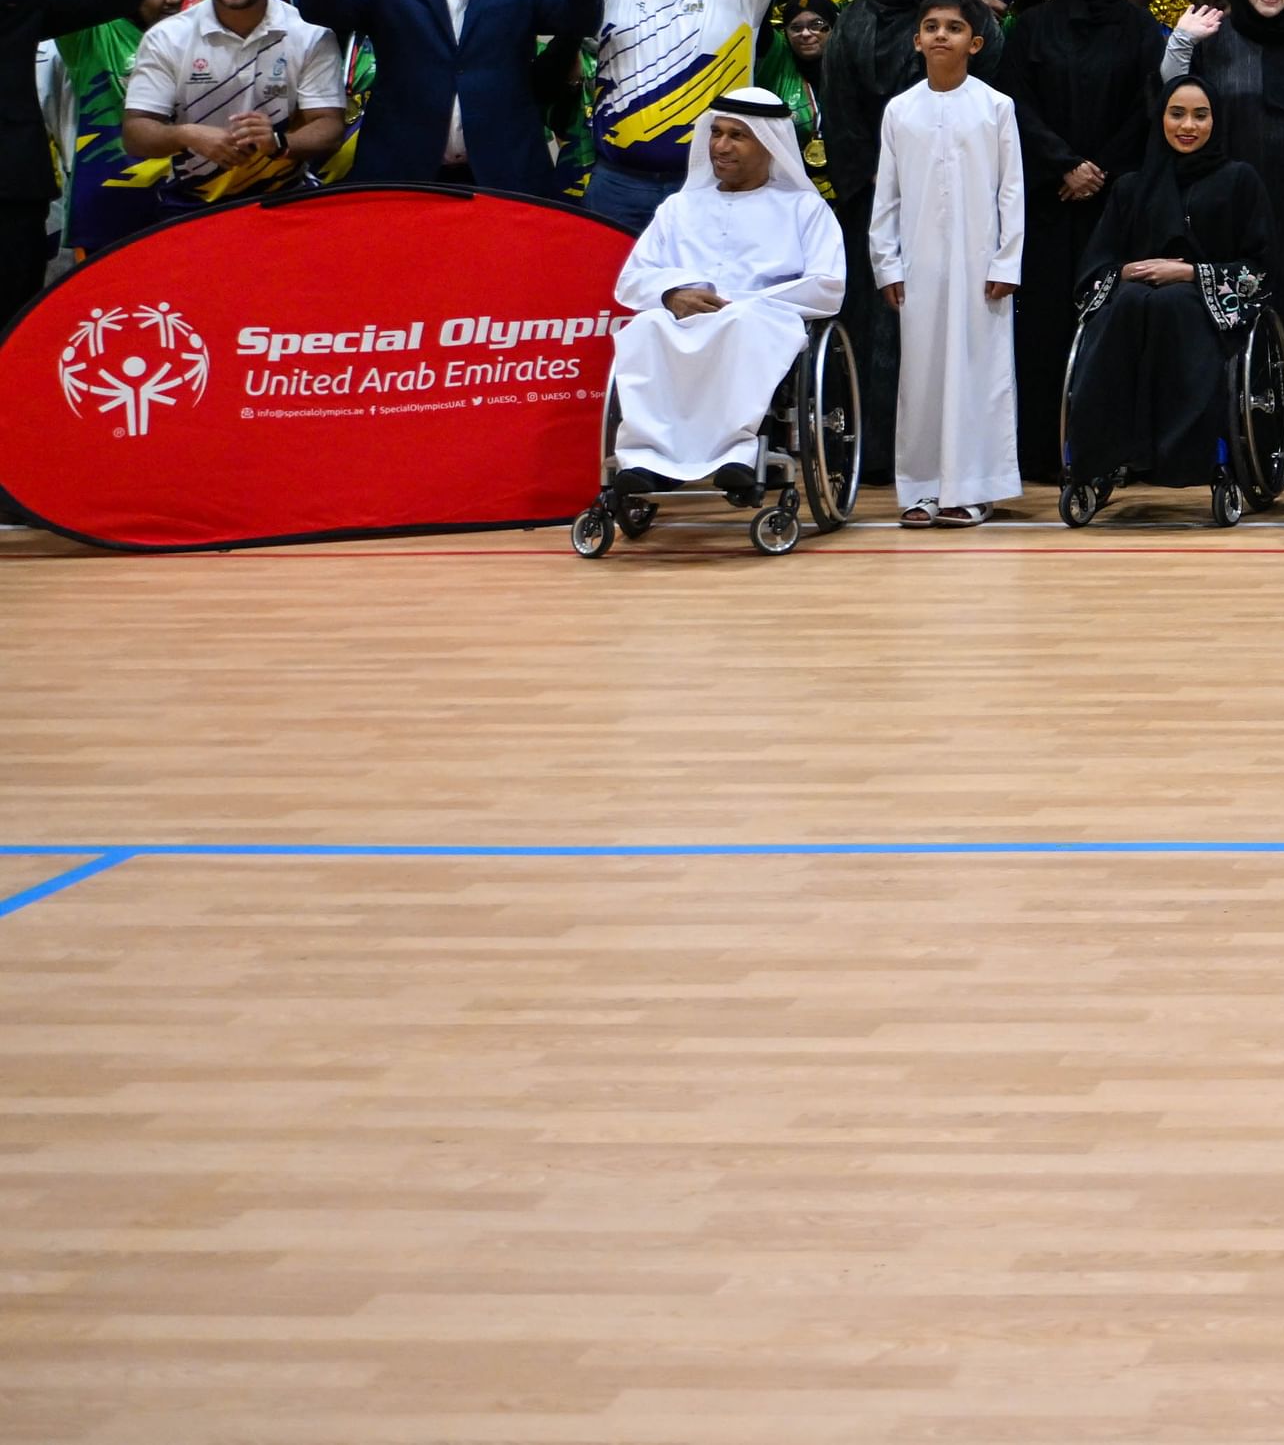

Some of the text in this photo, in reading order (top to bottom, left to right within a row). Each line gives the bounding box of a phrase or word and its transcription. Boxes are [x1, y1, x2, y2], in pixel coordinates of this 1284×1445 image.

[236, 309, 635, 362] Special Olympic
[244, 355, 581, 396] United Arab Emirates
[257, 407, 365, 418] info@specialolympics.ae
[379, 399, 467, 415] SpecialOlympicsUAE
[540, 391, 571, 401] UAESO
